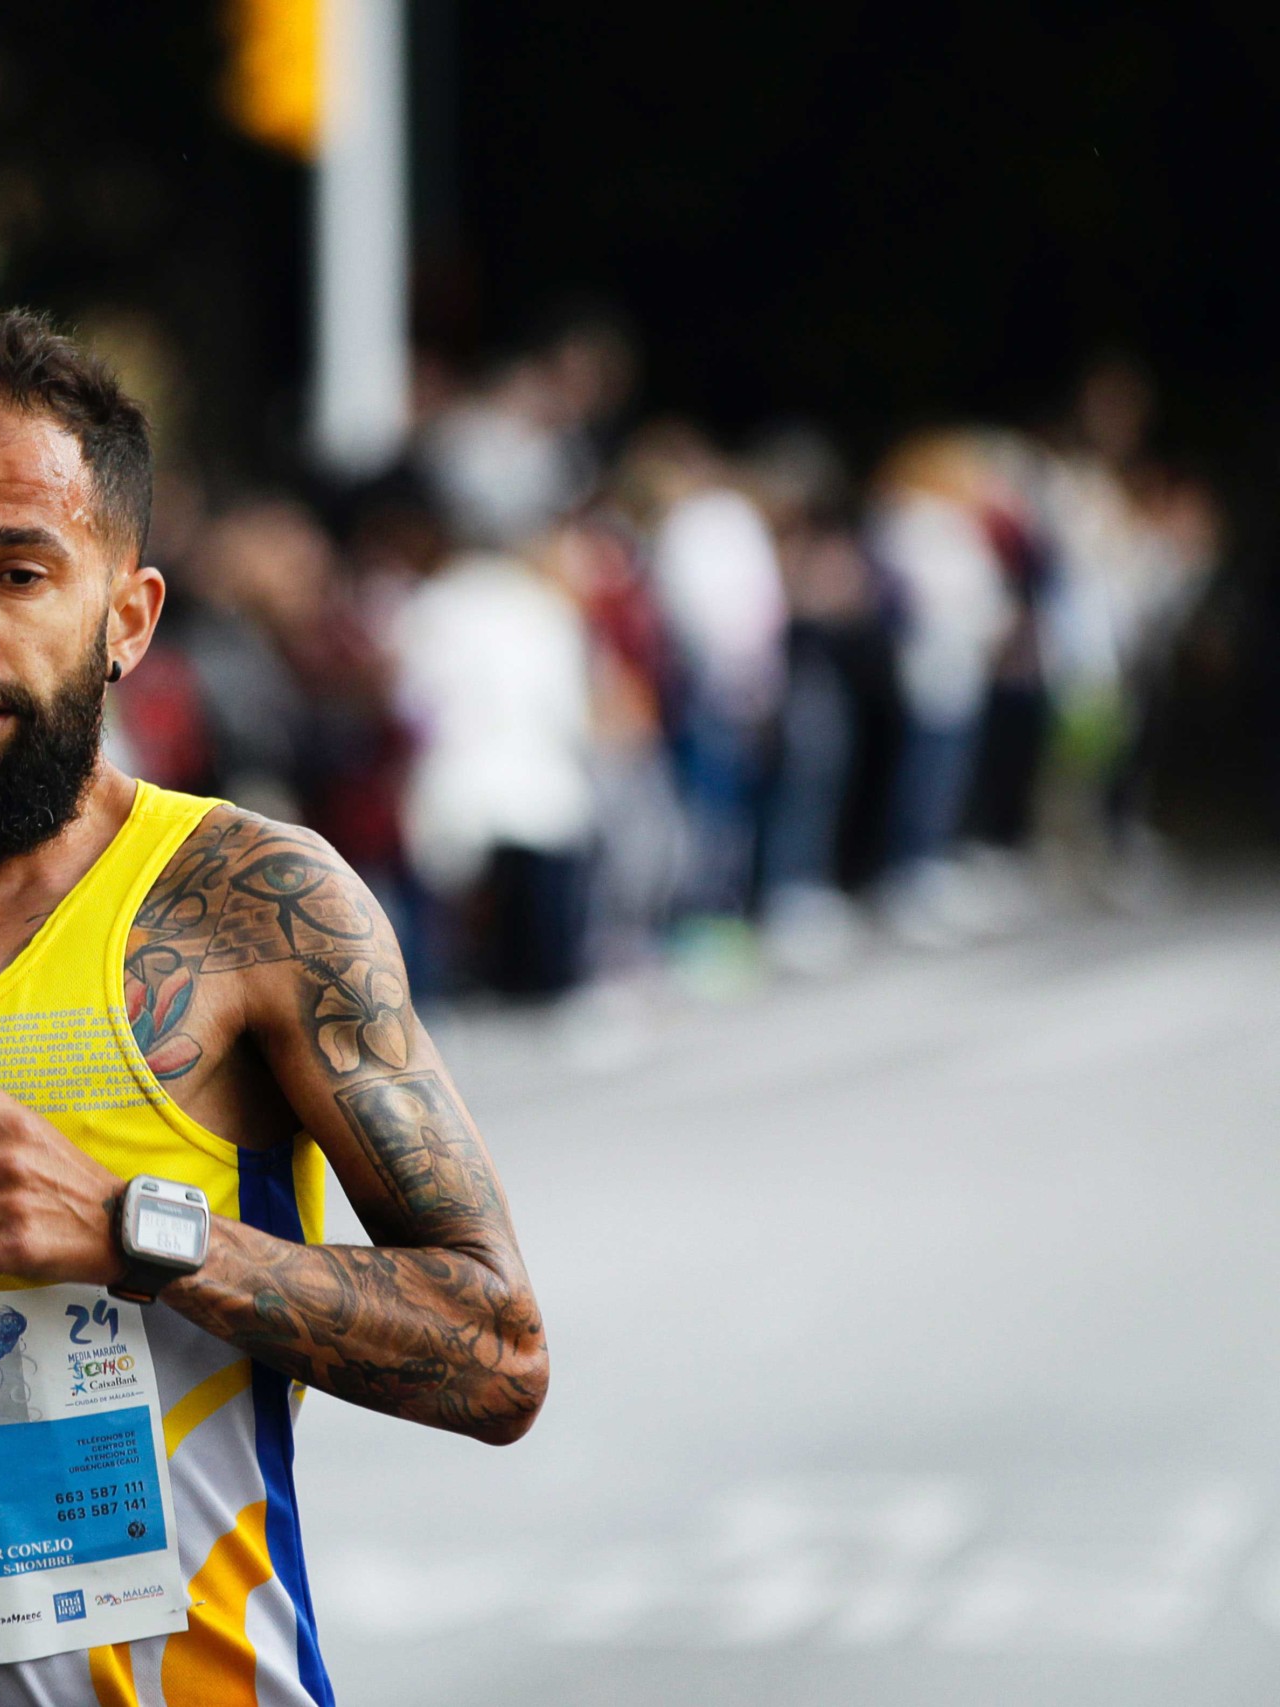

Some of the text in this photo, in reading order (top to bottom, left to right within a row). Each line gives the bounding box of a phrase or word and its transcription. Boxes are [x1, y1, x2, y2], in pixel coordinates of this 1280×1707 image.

[65, 1299, 118, 1344] 29
[68, 1344, 127, 1362] MEDIA MARATÓN
[90, 1374, 137, 1390] CaixaBank
[75, 1398, 98, 1406] CIUDAD
[100, 1395, 107, 1403] DE
[124, 1431, 135, 1439] DE
[92, 1441, 124, 1453] CENTRO
[127, 1447, 138, 1455] DE
[68, 1461, 115, 1474] URGENCIAS
[55, 1480, 144, 1504] 663 587 111
[57, 1497, 146, 1522] 663 587 141
[7, 1537, 73, 1560] CONEJO
[3, 1554, 75, 1575] S-HOMBRE
